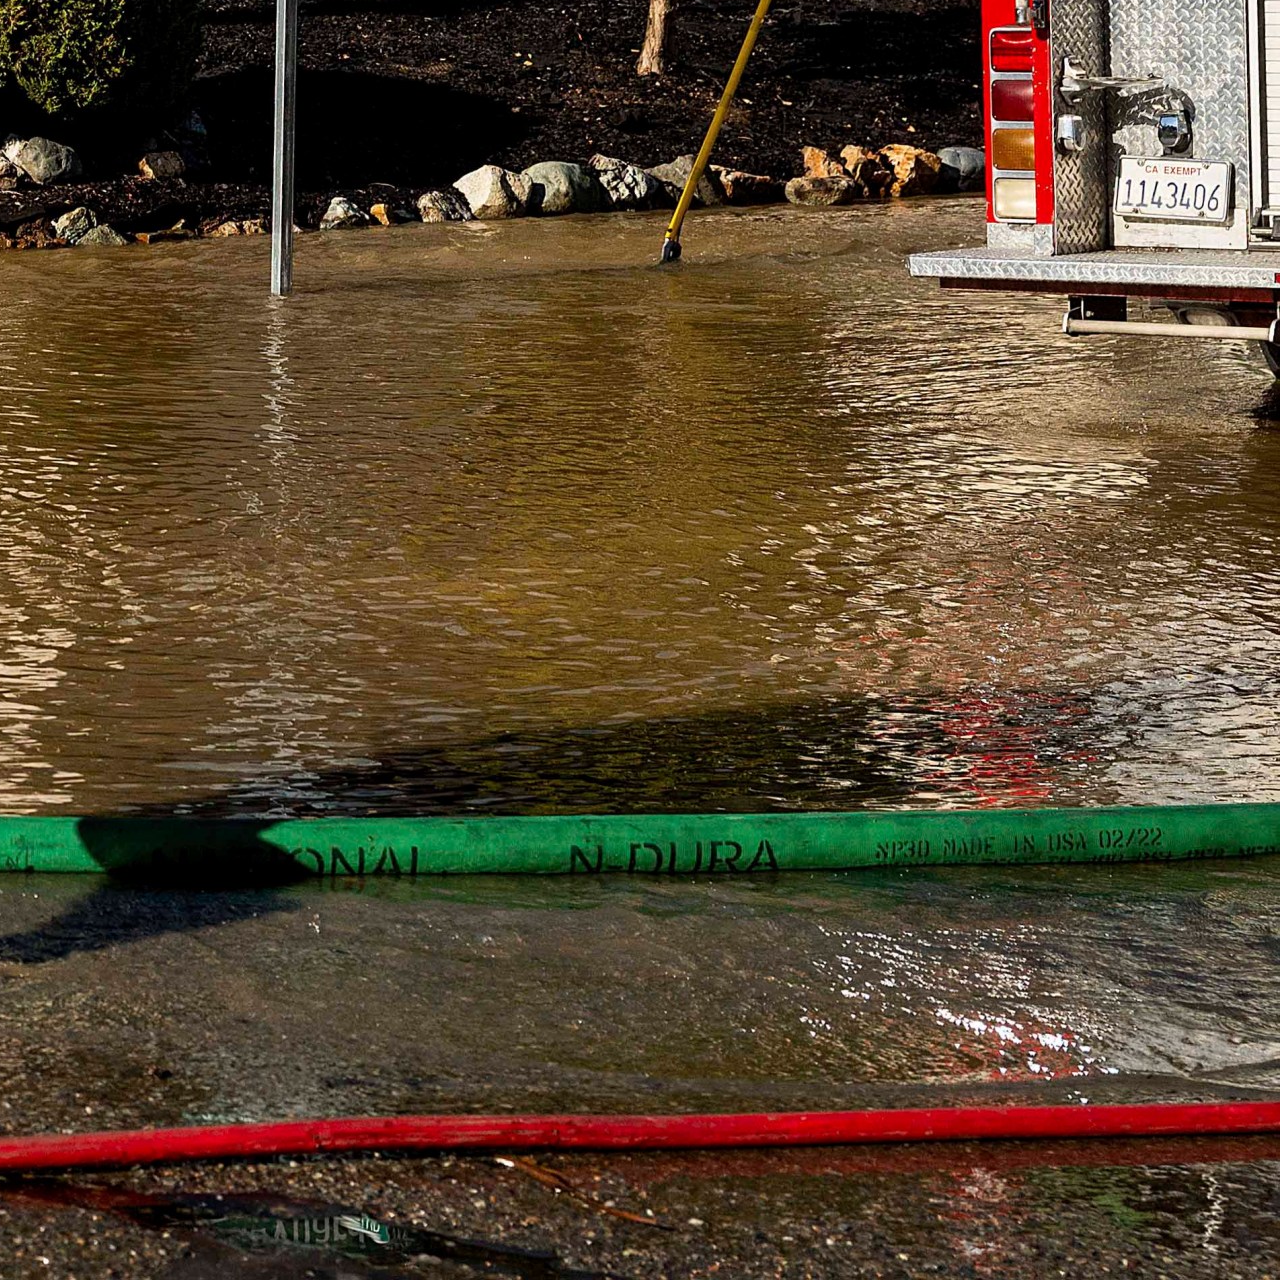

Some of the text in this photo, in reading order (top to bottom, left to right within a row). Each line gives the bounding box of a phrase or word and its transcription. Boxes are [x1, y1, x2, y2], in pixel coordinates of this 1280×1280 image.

[1145, 165, 1202, 176] CA EXEMPT
[1121, 179, 1221, 212] 1143406
[569, 839, 779, 874] N-DURA
[943, 836, 996, 856] MADE
[1014, 834, 1035, 854] IN
[1047, 831, 1088, 852] USA
[1098, 827, 1163, 849] 02/22
